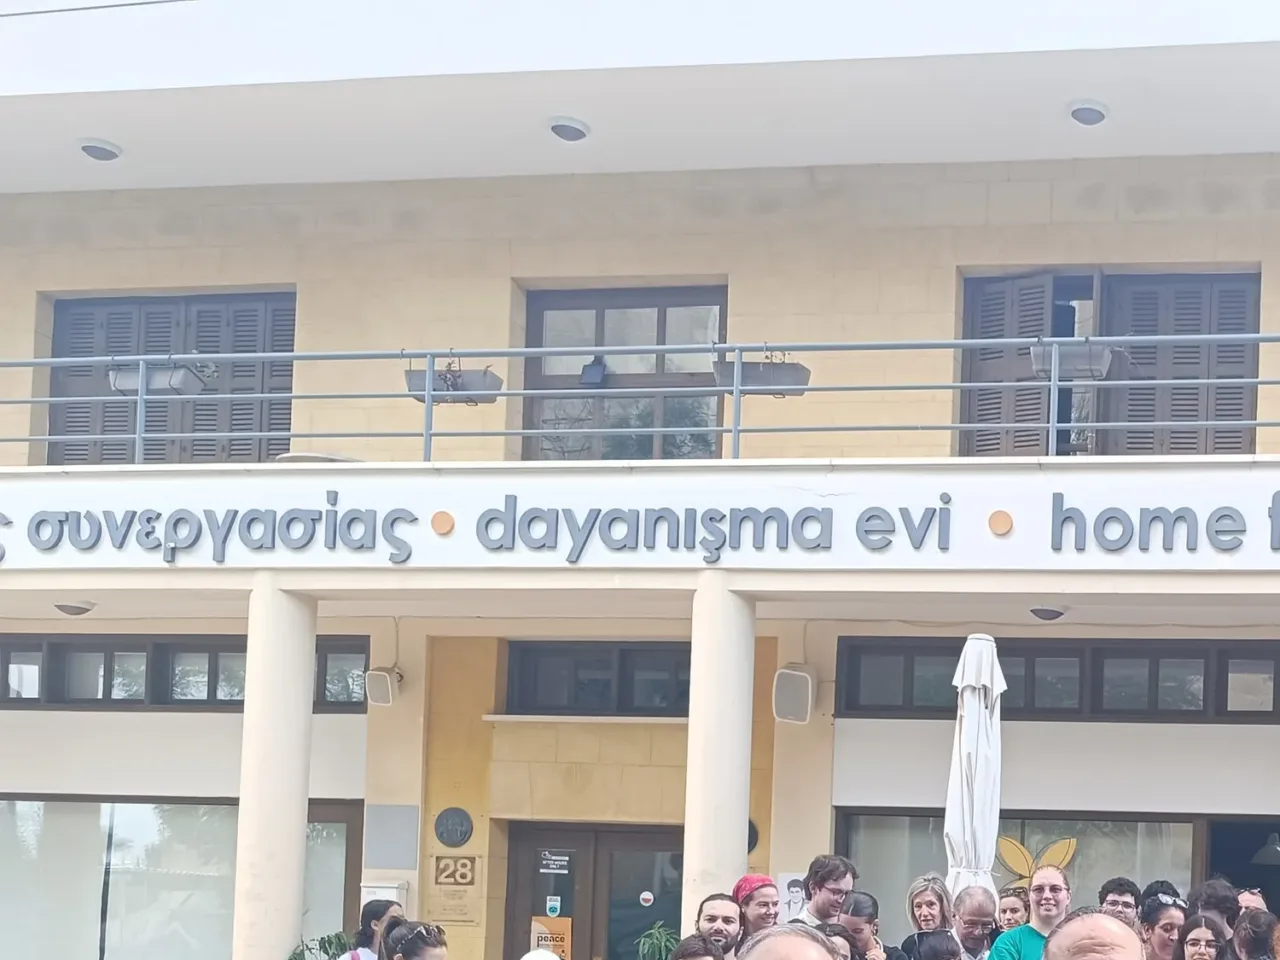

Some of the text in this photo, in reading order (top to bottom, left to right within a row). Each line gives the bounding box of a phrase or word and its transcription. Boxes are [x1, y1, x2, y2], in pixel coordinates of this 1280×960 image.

[28, 490, 418, 566] συνεργασίας
[476, 493, 952, 566] dayanışma evi
[1051, 493, 1247, 554] home
[437, 858, 472, 884] 28
[537, 934, 565, 947] peace
